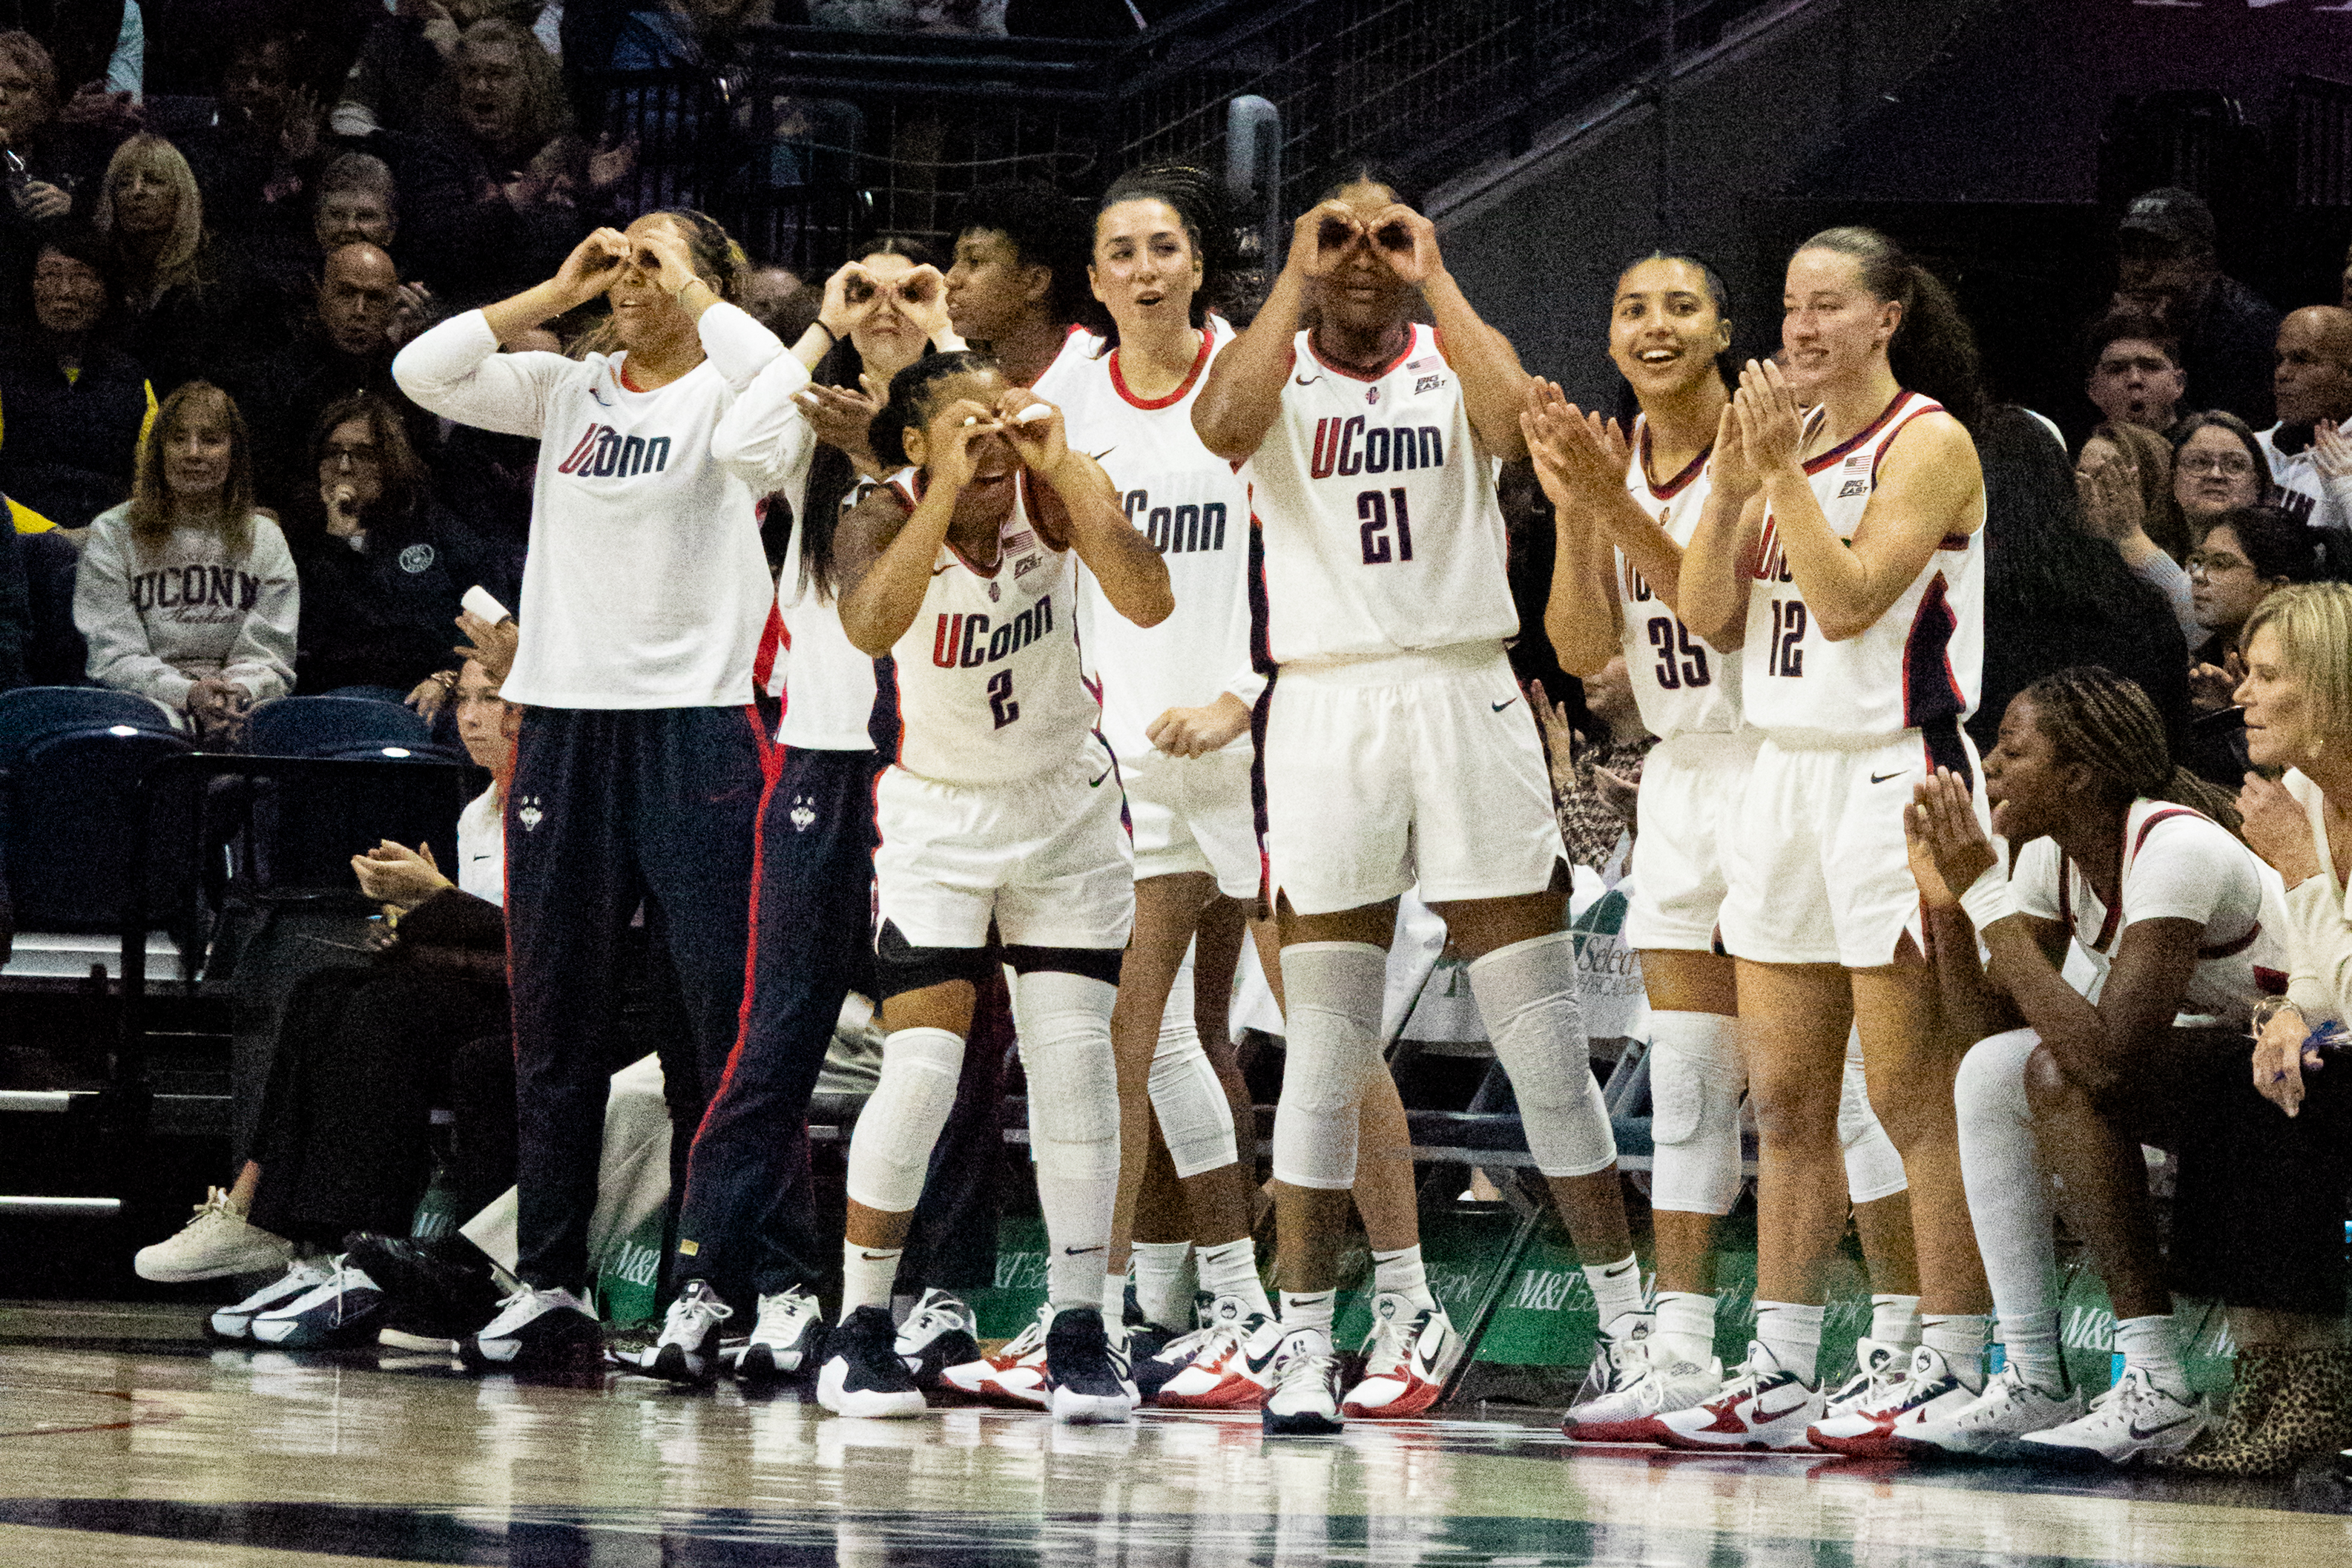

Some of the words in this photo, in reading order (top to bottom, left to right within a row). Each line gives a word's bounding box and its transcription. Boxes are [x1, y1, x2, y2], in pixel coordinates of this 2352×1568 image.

[1311, 414, 1444, 479] UConn
[1116, 489, 1228, 554] Conn
[1357, 487, 1414, 564] 21
[134, 564, 260, 613] UCONN
[932, 594, 1053, 669] UConn
[1647, 616, 1711, 691] 35
[1769, 599, 1808, 678] 12
[986, 668, 1020, 731] 2
[1509, 1269, 1582, 1311] M&T
[2061, 1305, 2113, 1351] M&
